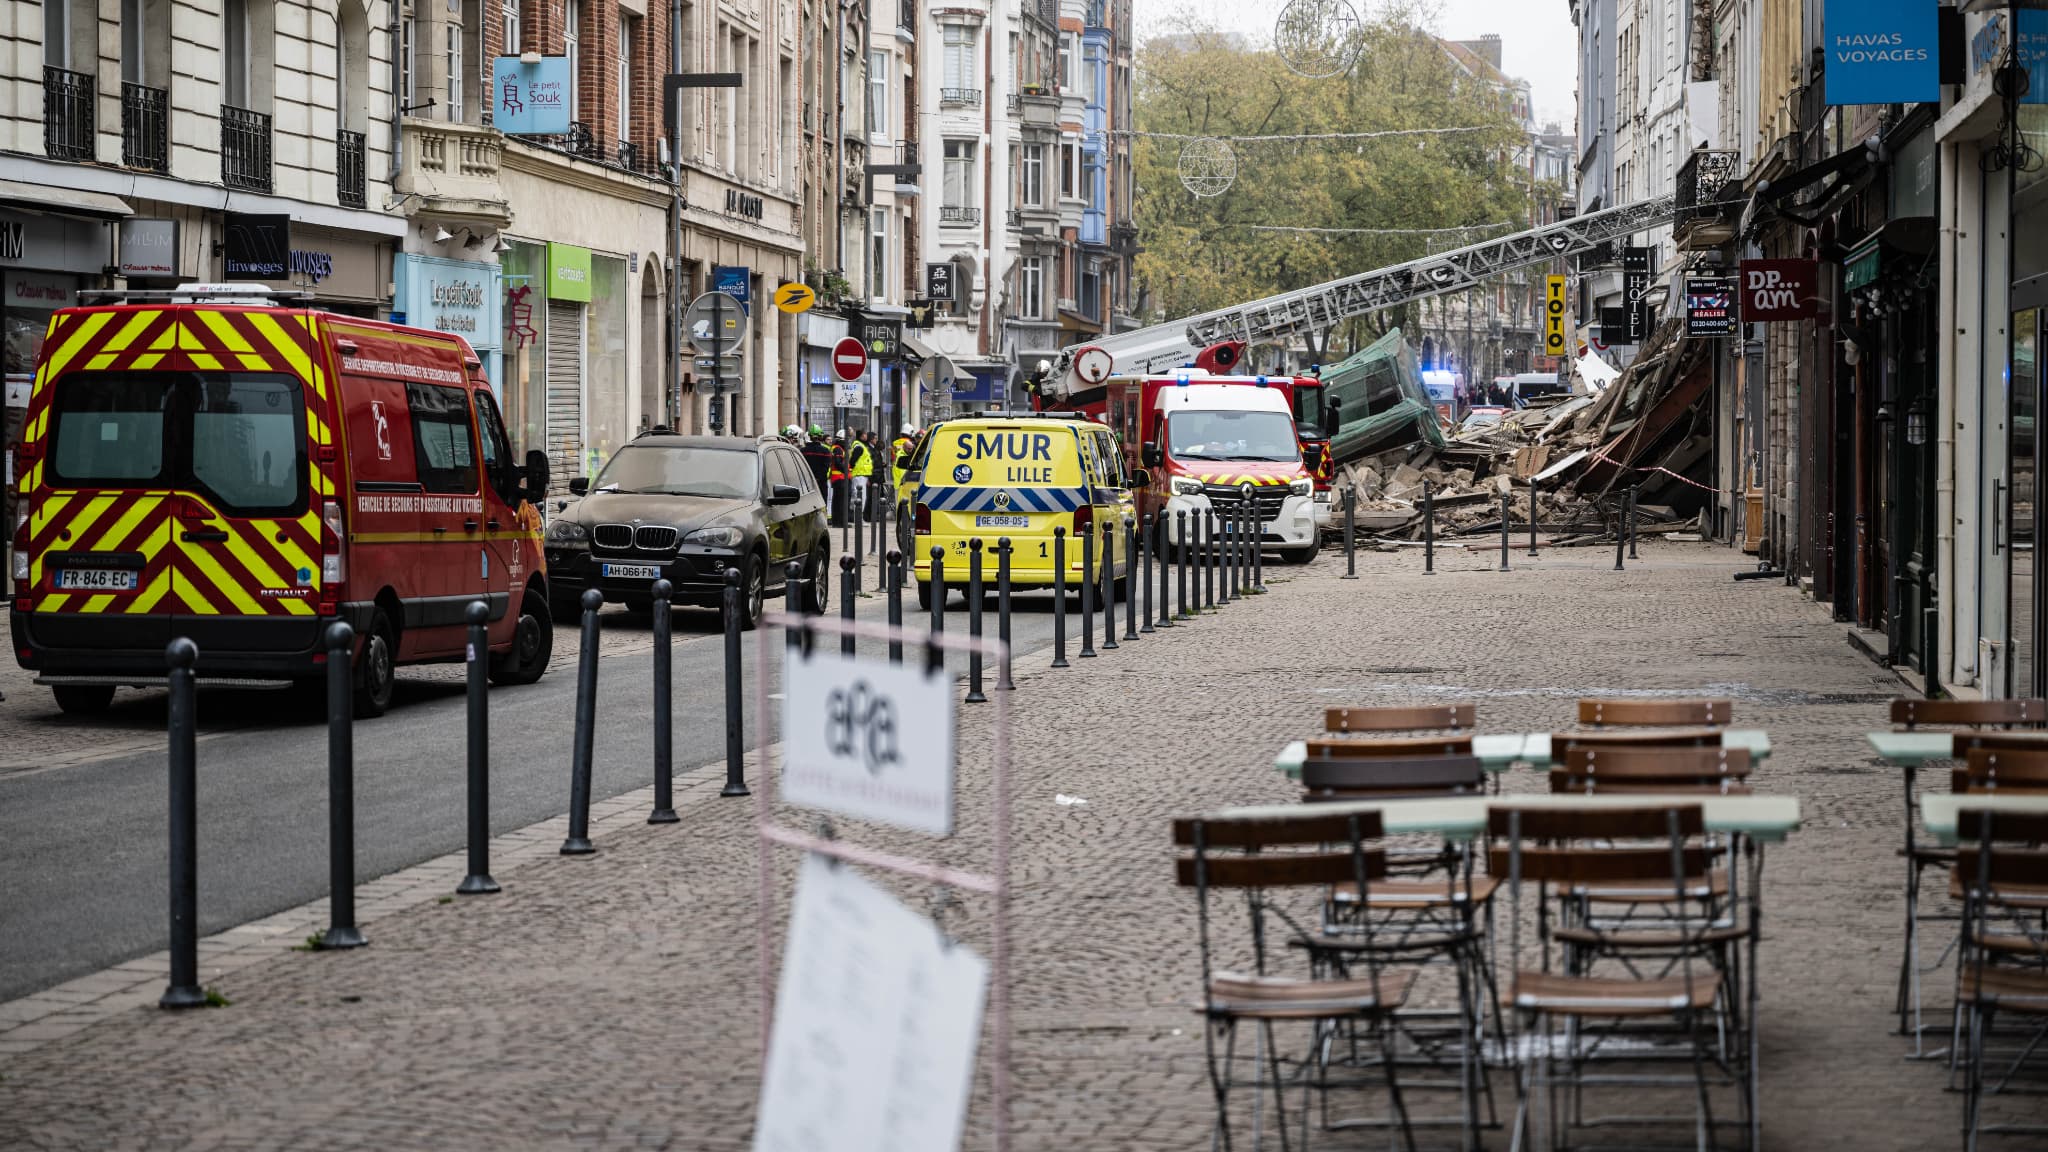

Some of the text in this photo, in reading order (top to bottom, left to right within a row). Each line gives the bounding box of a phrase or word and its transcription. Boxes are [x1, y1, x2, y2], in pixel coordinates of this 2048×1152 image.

[1836, 33, 1903, 47] HAVAS
[1838, 48, 1928, 63] VOYAGES
[528, 80, 561, 91] Le petit
[529, 90, 561, 103] Souk
[431, 276, 444, 303] Le
[1629, 275, 1641, 337] HOTEL
[1754, 289, 1801, 310] am
[1548, 282, 1563, 348] TOTO
[865, 325, 897, 339] RIEN
[956, 432, 1051, 461] SMUR
[1007, 467, 1052, 483] LILLE
[357, 496, 383, 513] VEHICULE
[383, 497, 391, 513] DE
[391, 497, 413, 513] SECOURS
[413, 497, 420, 513] ET
[452, 498, 462, 513] AUX
[462, 498, 482, 514] VICTIMES
[1038, 541, 1049, 558] 1
[62, 571, 129, 586] FR-846-EC
[608, 566, 654, 577] AH-066-FN
[260, 589, 310, 597] RENAULT
